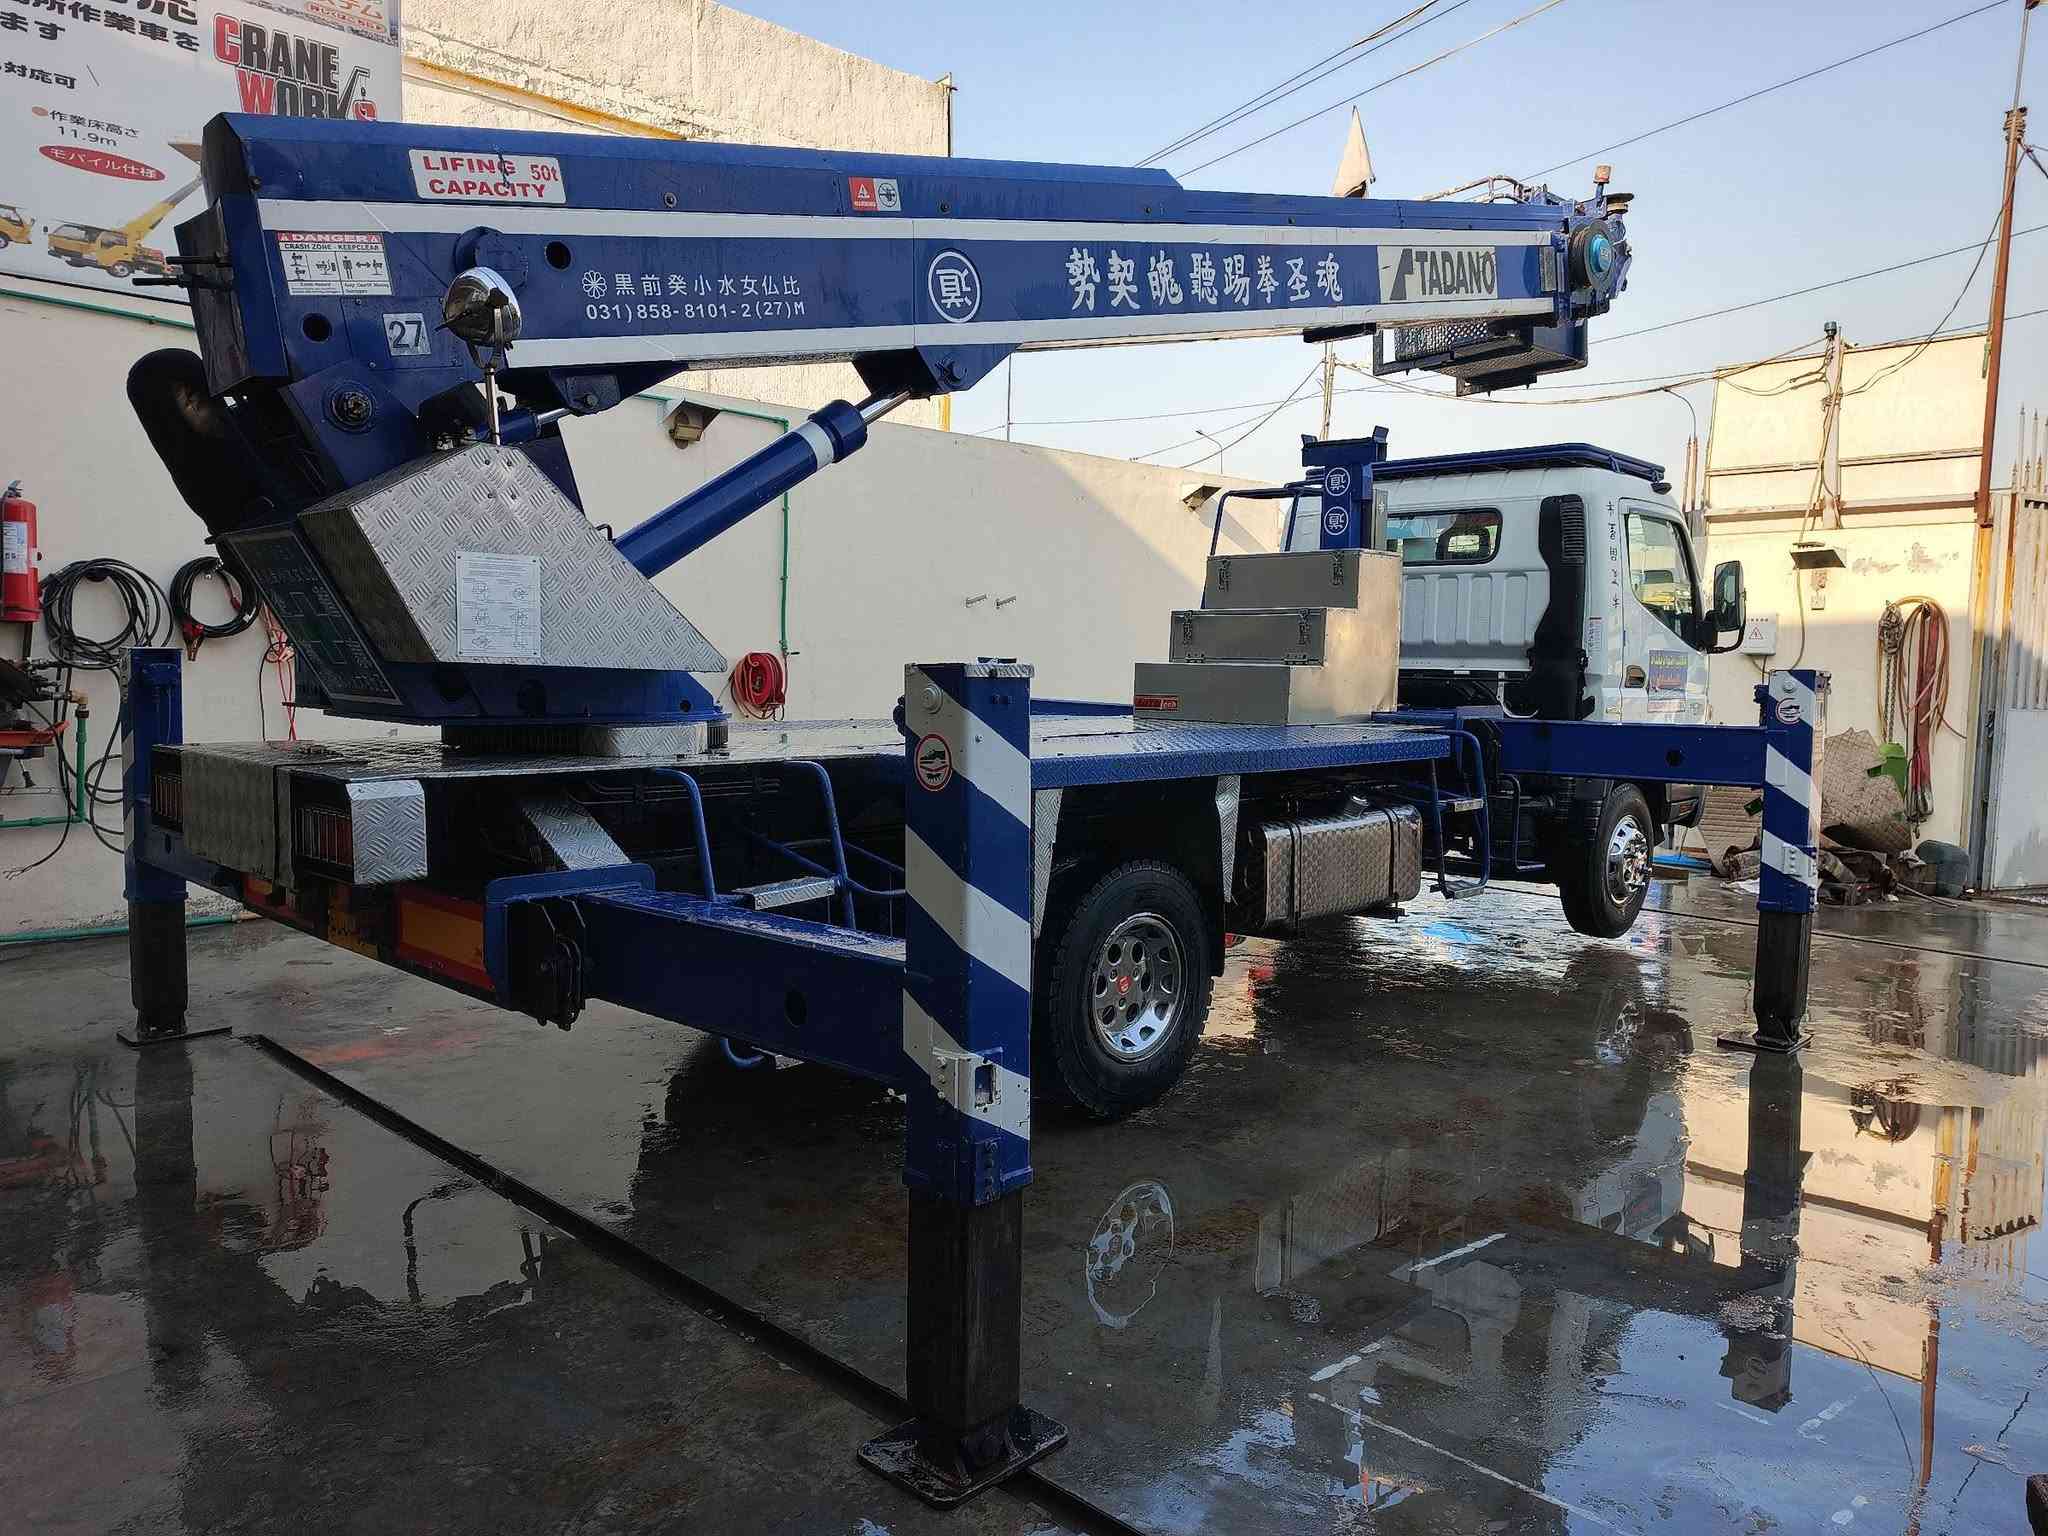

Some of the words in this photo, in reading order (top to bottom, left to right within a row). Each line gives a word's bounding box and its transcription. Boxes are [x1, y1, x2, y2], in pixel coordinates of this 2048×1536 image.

[213, 13, 341, 91] CRANE
[49, 110, 139, 138] 作業床高さ
[57, 126, 118, 147] 11.9m
[49, 147, 158, 179] モバイル仕様
[423, 155, 516, 176] LIFING
[530, 164, 559, 182] 50t
[429, 179, 545, 198] CAPACITY
[291, 232, 367, 244] DANGER
[1415, 249, 1496, 296] TADANO
[389, 320, 422, 349] 27
